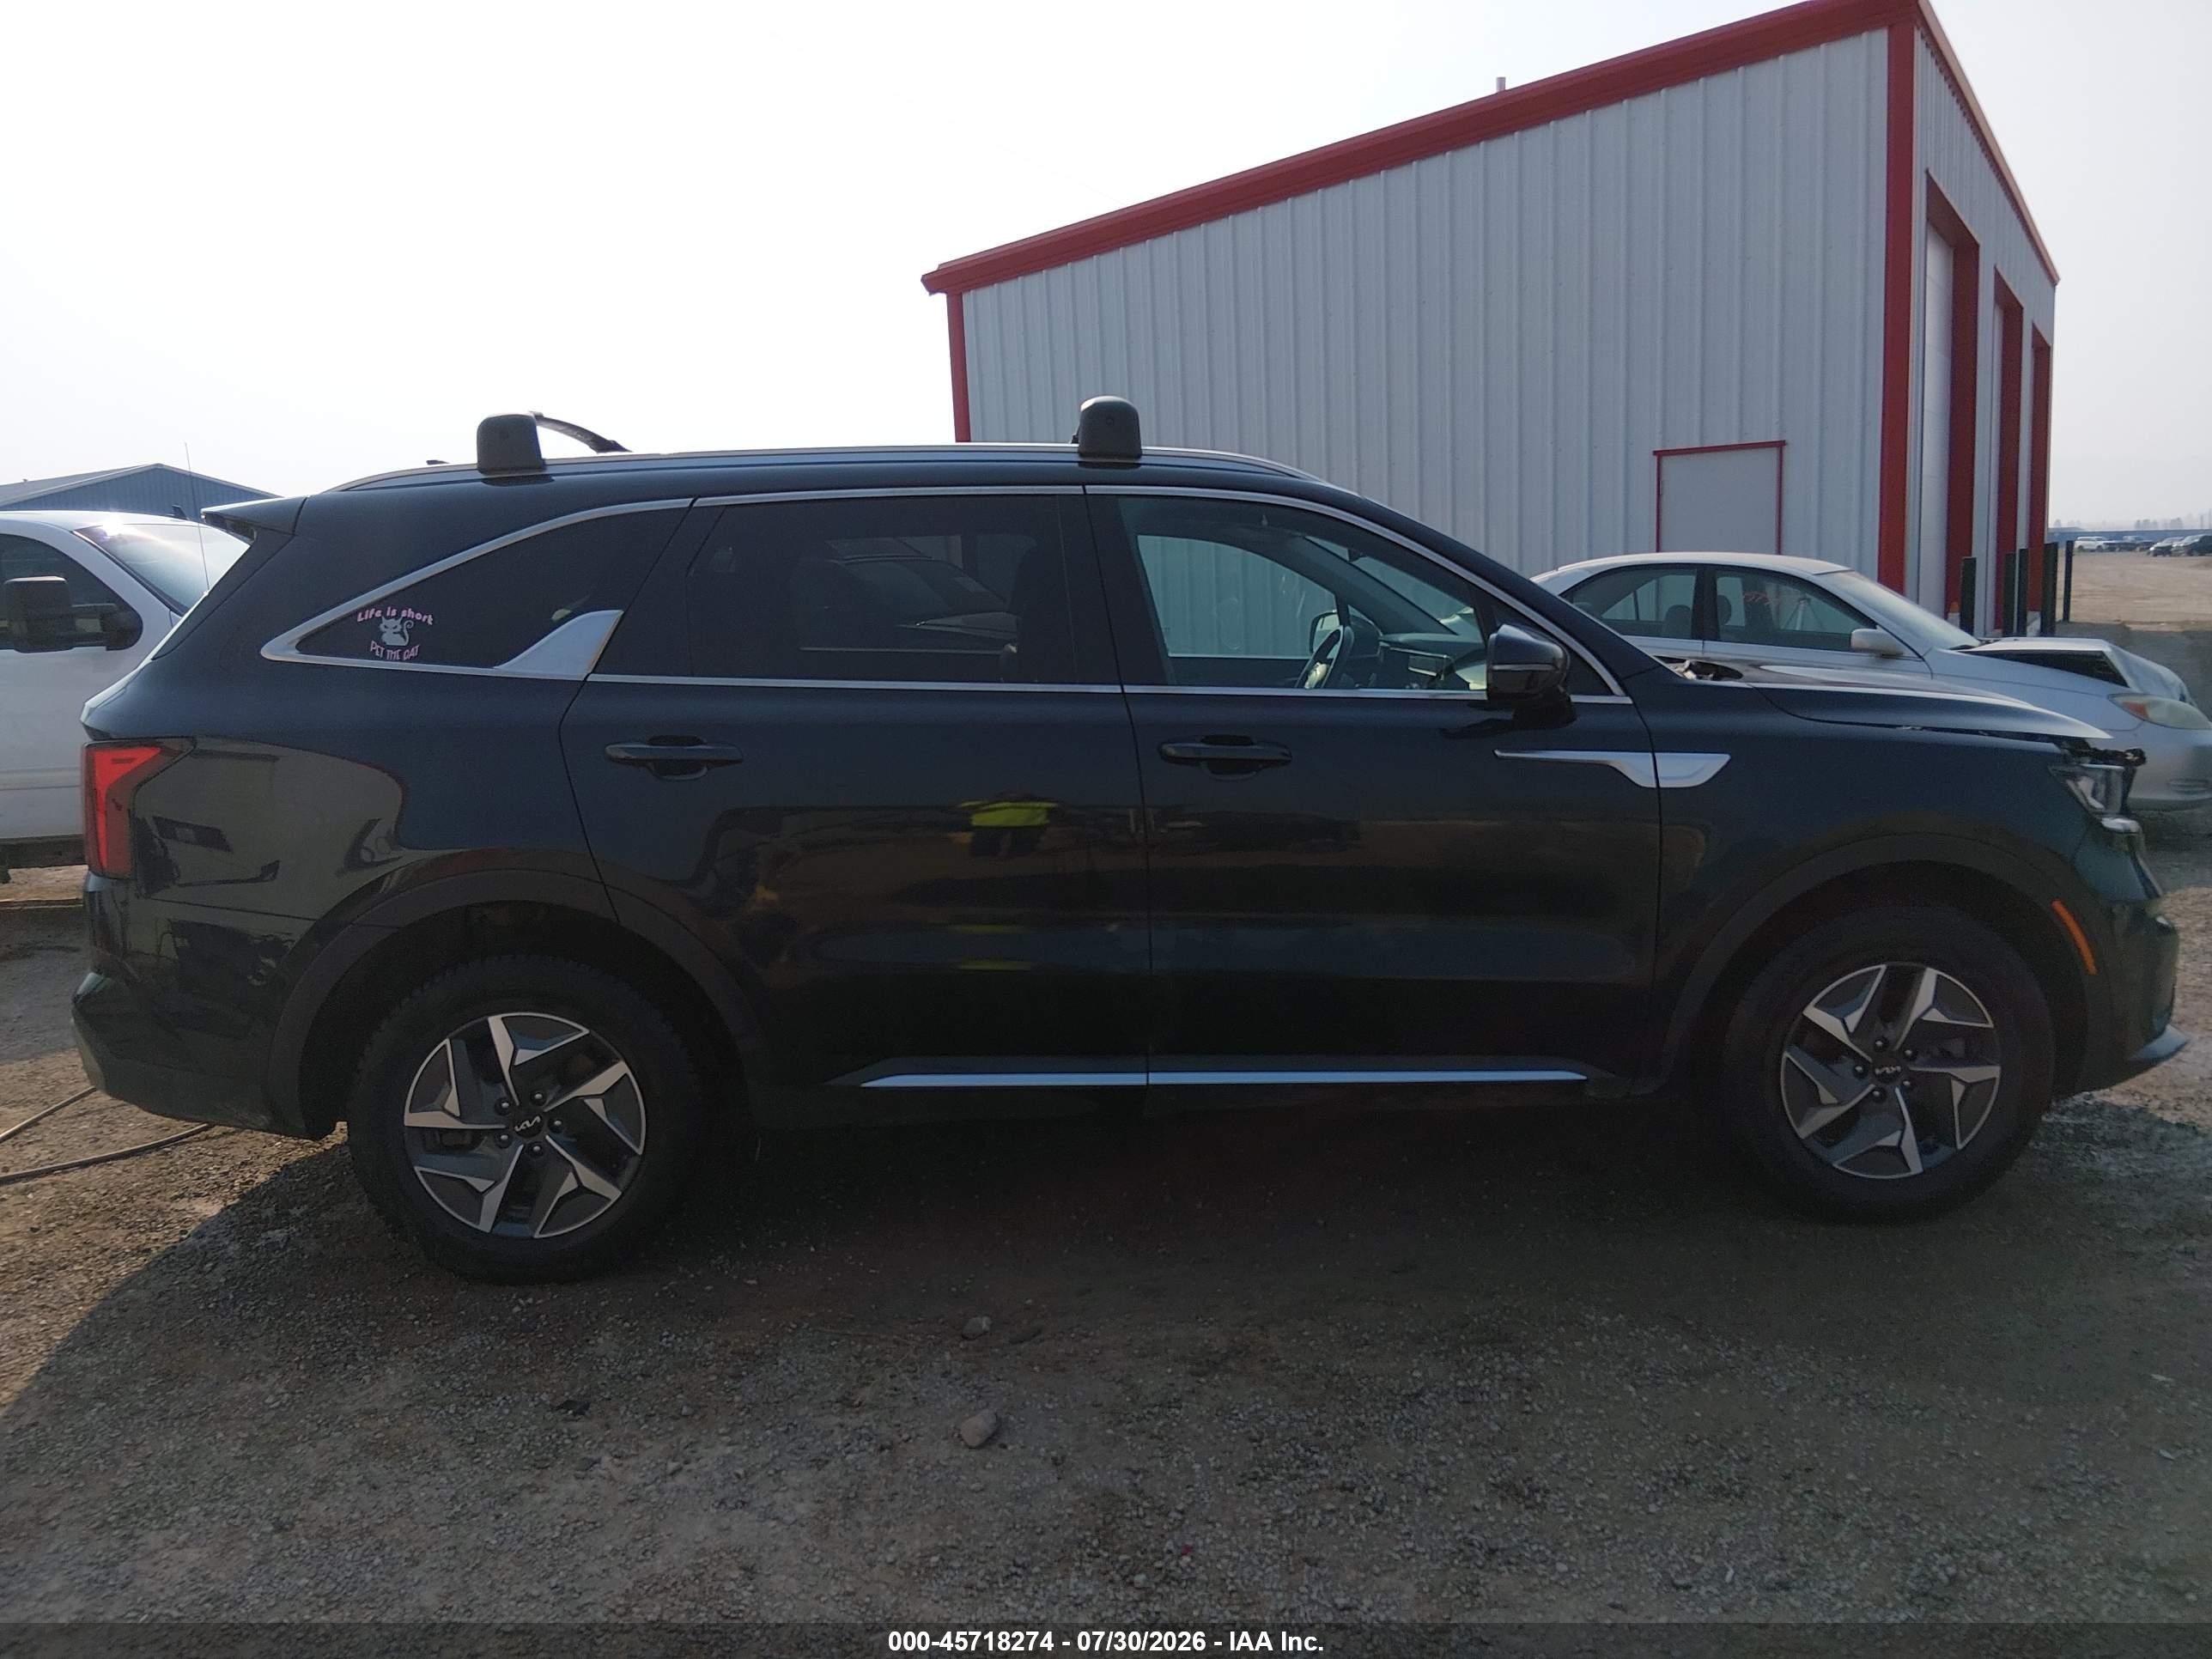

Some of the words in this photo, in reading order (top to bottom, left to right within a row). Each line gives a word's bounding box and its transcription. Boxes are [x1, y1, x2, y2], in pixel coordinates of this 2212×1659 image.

[357, 608, 382, 622] Life
[386, 606, 397, 617] is
[401, 608, 434, 625] short
[370, 640, 385, 658] PET
[386, 649, 401, 660] THE
[403, 645, 420, 660] CAT
